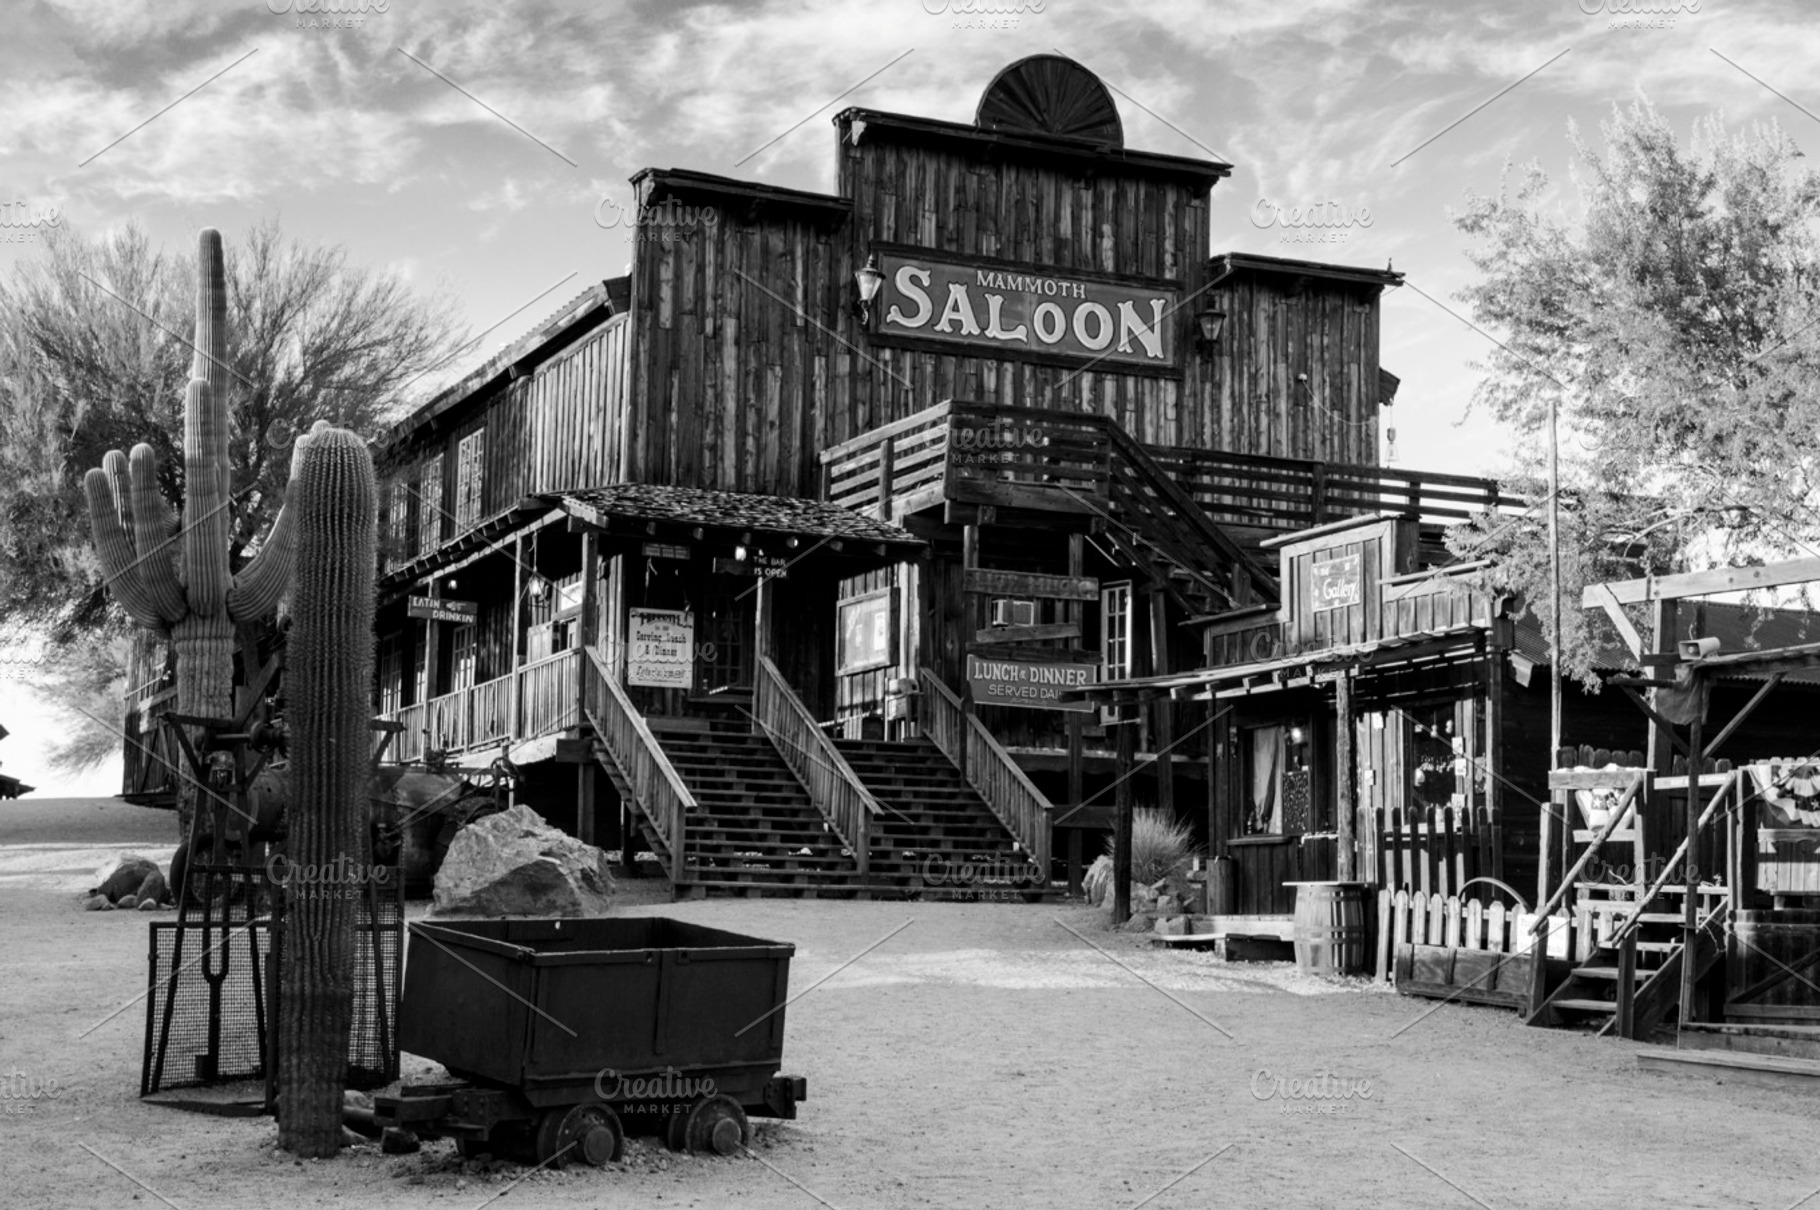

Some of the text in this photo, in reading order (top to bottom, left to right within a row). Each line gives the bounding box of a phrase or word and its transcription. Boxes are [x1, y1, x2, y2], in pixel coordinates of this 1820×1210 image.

[976, 270, 1086, 299] MAMMOTH
[886, 265, 1166, 360] SALOON
[752, 556, 768, 565] THE
[753, 568, 787, 578] IS OPEN
[1323, 578, 1357, 602] Gallery
[412, 596, 440, 609] EATIN
[432, 610, 474, 622] DRINKIN
[974, 662, 1087, 686] LUNCH & DINNER
[988, 684, 1062, 700] SERVED DAI
